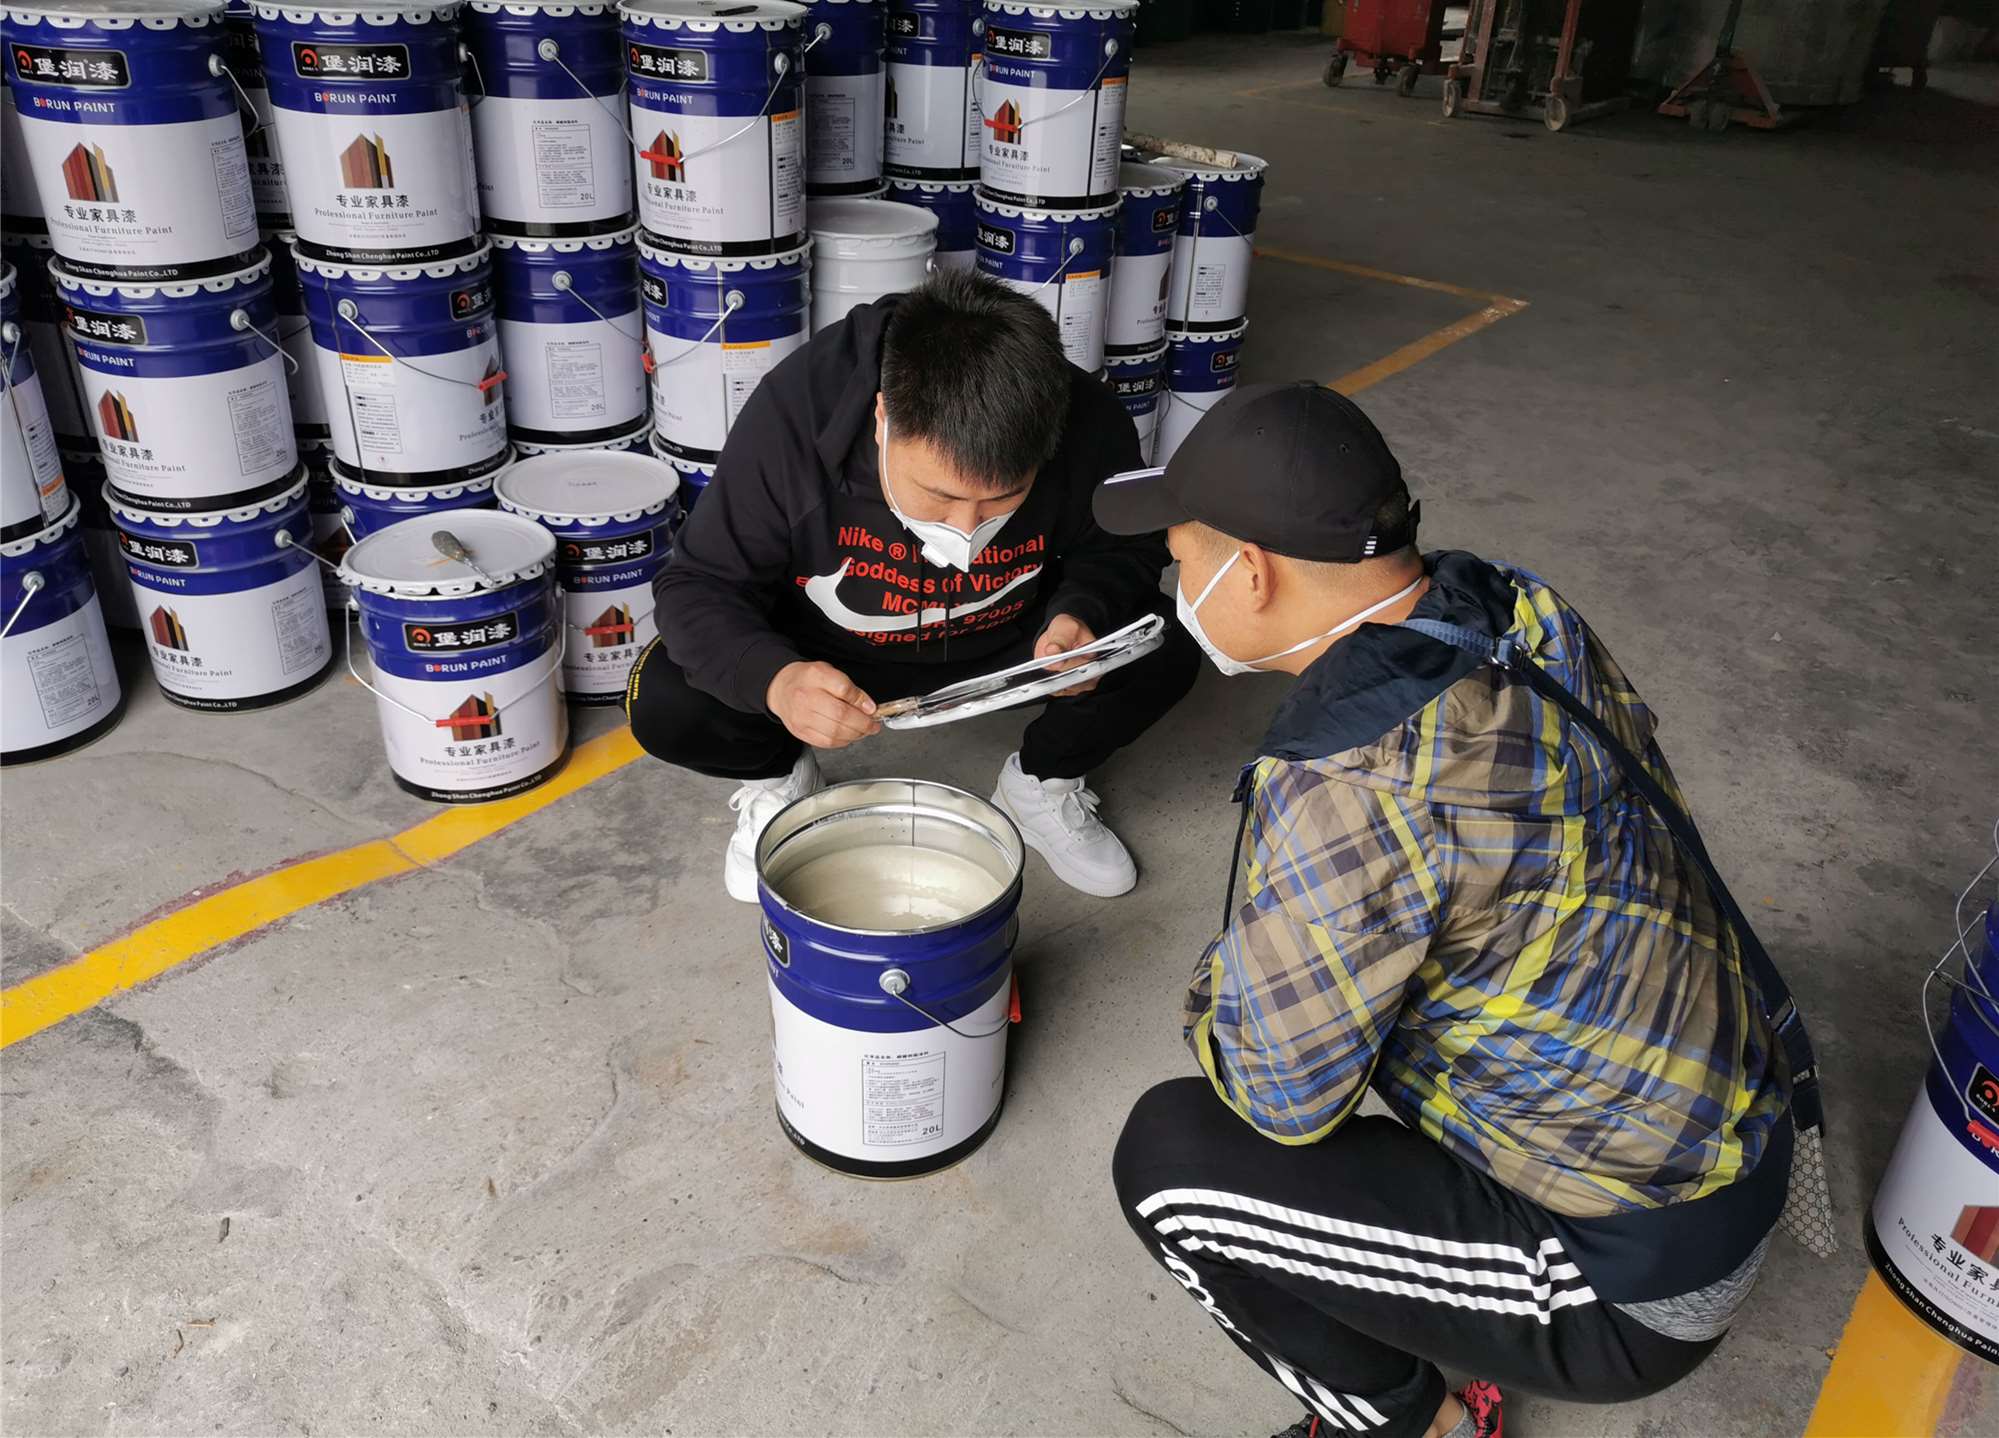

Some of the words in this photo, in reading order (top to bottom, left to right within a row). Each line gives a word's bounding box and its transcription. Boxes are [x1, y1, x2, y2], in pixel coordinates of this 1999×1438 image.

[995, 35, 1043, 55] 堡润漆
[34, 57, 118, 80] 堡润漆
[321, 54, 401, 74] 堡润漆
[640, 54, 699, 76] 堡润漆
[1010, 67, 1034, 79] PAINT
[33, 96, 71, 111] BORUN
[74, 101, 116, 113] PAINT
[314, 91, 356, 104] BORUN
[359, 93, 397, 104] PAINT
[662, 91, 693, 105] PAINT
[336, 194, 410, 208] 专业家具漆
[580, 192, 595, 201] 20L
[64, 205, 137, 223] 专业家具漆
[314, 208, 366, 220] Professional
[368, 212, 413, 220] Furniture
[416, 208, 438, 218] Paint
[702, 206, 725, 215] Paint
[95, 225, 142, 236] Furniture
[145, 225, 173, 235] Paint
[396, 251, 414, 259] Paint
[128, 270, 148, 278] Paint
[74, 315, 137, 340] 堡润漆
[101, 354, 135, 367] PAINT
[161, 464, 186, 472] Paint
[129, 540, 189, 563] 堡润漆
[583, 540, 648, 560] 堡润漆
[838, 527, 884, 552] Nike
[911, 535, 1044, 565] Iational
[155, 575, 186, 587] PAINT
[612, 568, 643, 583] PAINT
[941, 573, 963, 594] of
[969, 562, 1040, 593] Victor
[963, 600, 1025, 625] 97005
[434, 623, 511, 646] 堡润漆
[848, 628, 931, 643] signed
[425, 663, 468, 673] BORUN
[470, 655, 507, 670] PAINT
[444, 737, 515, 757] 专业家具漆
[476, 751, 518, 764] Furniture
[922, 1124, 941, 1136] 20L
[1898, 1217, 1960, 1283] Professional
[1885, 1263, 1905, 1290] Zhong
[1905, 1287, 1925, 1309] Shan
[1925, 1302, 1973, 1343] Chenghua
